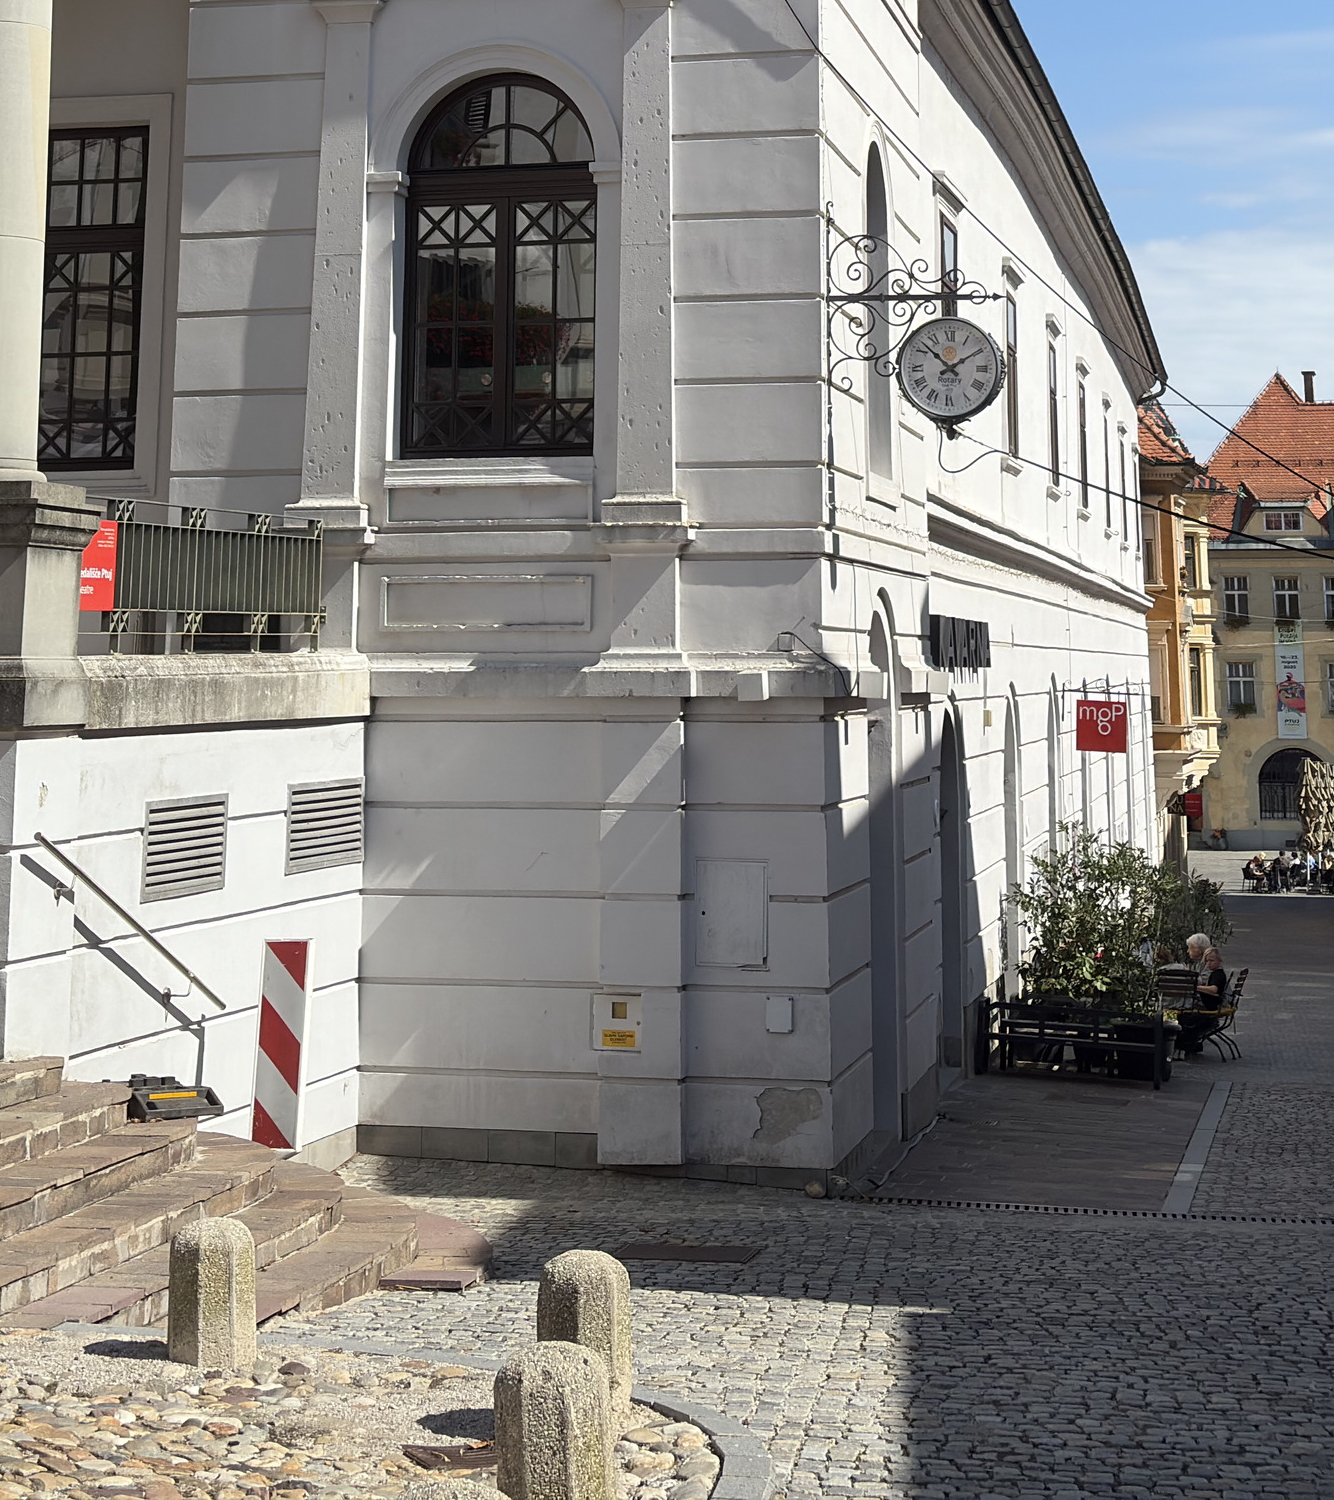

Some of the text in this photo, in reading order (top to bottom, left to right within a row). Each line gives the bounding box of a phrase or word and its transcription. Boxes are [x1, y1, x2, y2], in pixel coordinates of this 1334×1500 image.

[938, 376, 962, 385] Rotary
[80, 567, 113, 581] edališče Ptuj
[80, 585, 94, 595] eatre
[937, 615, 991, 667] KAVARNA
